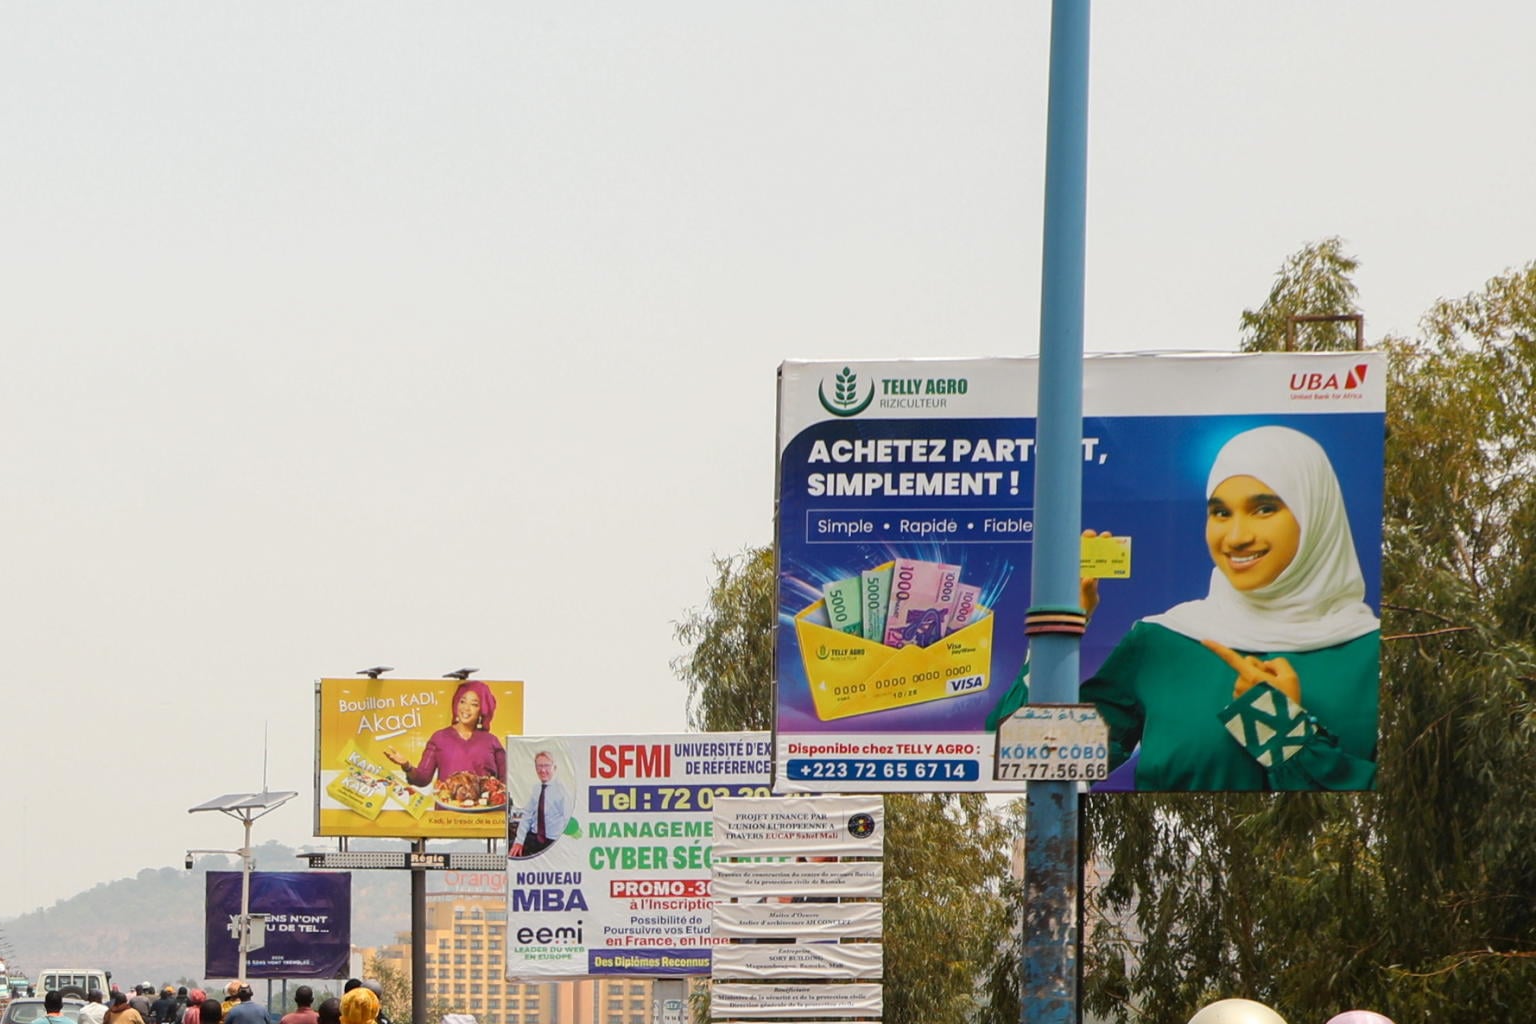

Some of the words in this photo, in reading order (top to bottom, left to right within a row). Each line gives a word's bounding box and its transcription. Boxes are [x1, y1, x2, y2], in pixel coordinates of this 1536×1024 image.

[882, 379, 922, 395] TELLY
[925, 378, 968, 394] AGRO
[1290, 373, 1338, 391] UBA
[879, 398, 947, 409] RIZICULTEUR
[807, 438, 947, 463] ACHETEZ
[952, 438, 1108, 465] PARTT,
[807, 471, 1003, 496] SIMPLEMENT
[1010, 471, 1019, 496] !
[818, 519, 874, 536] Simple
[900, 518, 958, 536] Rapide
[984, 518, 1033, 533] Fiable
[867, 577, 880, 610] 5000
[829, 589, 848, 623] 5000
[947, 643, 962, 651] Visa
[834, 683, 866, 696] 0000
[875, 676, 906, 689] 0000
[912, 671, 940, 684] 0000
[945, 664, 972, 677] 0000
[951, 676, 983, 692] VISA
[339, 696, 395, 714] Bouillon
[357, 708, 422, 735] Akadi
[788, 743, 860, 757] Disponible
[862, 743, 894, 754] chez
[896, 744, 932, 754] TELLY
[935, 744, 974, 755] AGRO
[590, 744, 671, 779] ISFMI
[674, 739, 744, 757] UNIVERSITÉ
[686, 761, 701, 775] DE
[703, 757, 771, 775] RÉFÉRENCE
[800, 763, 848, 778] +223
[854, 763, 877, 778] 72
[883, 763, 908, 778] 65
[915, 763, 938, 778] 67
[944, 763, 965, 778] 14
[1000, 764, 1106, 778] 77.77.56.66
[596, 787, 637, 810] Tel
[658, 787, 691, 810] 72
[736, 813, 768, 821] PROJET
[589, 821, 713, 838] MANAGEME
[725, 832, 764, 840] TRAVERS
[589, 846, 668, 870] CYBER
[517, 872, 581, 885] NOUVEAU
[612, 881, 685, 896] PROMO
[512, 889, 589, 912] MBA
[630, 898, 638, 910] à
[641, 898, 722, 912] l'Inscriptio
[263, 914, 287, 923] ENS
[290, 915, 328, 923] N'ONT
[631, 916, 687, 925] Possibilité
[689, 916, 703, 925] de
[279, 924, 295, 932] DE
[517, 920, 583, 944] eemi
[604, 926, 662, 935] Poursuivre
[664, 927, 684, 935] vos
[686, 925, 711, 935] Etud
[606, 938, 622, 946] en
[626, 936, 677, 947] France,
[680, 938, 697, 946] en
[595, 957, 613, 967] Des
[614, 956, 660, 968] Diplômes
[661, 957, 710, 967] Reconnus
